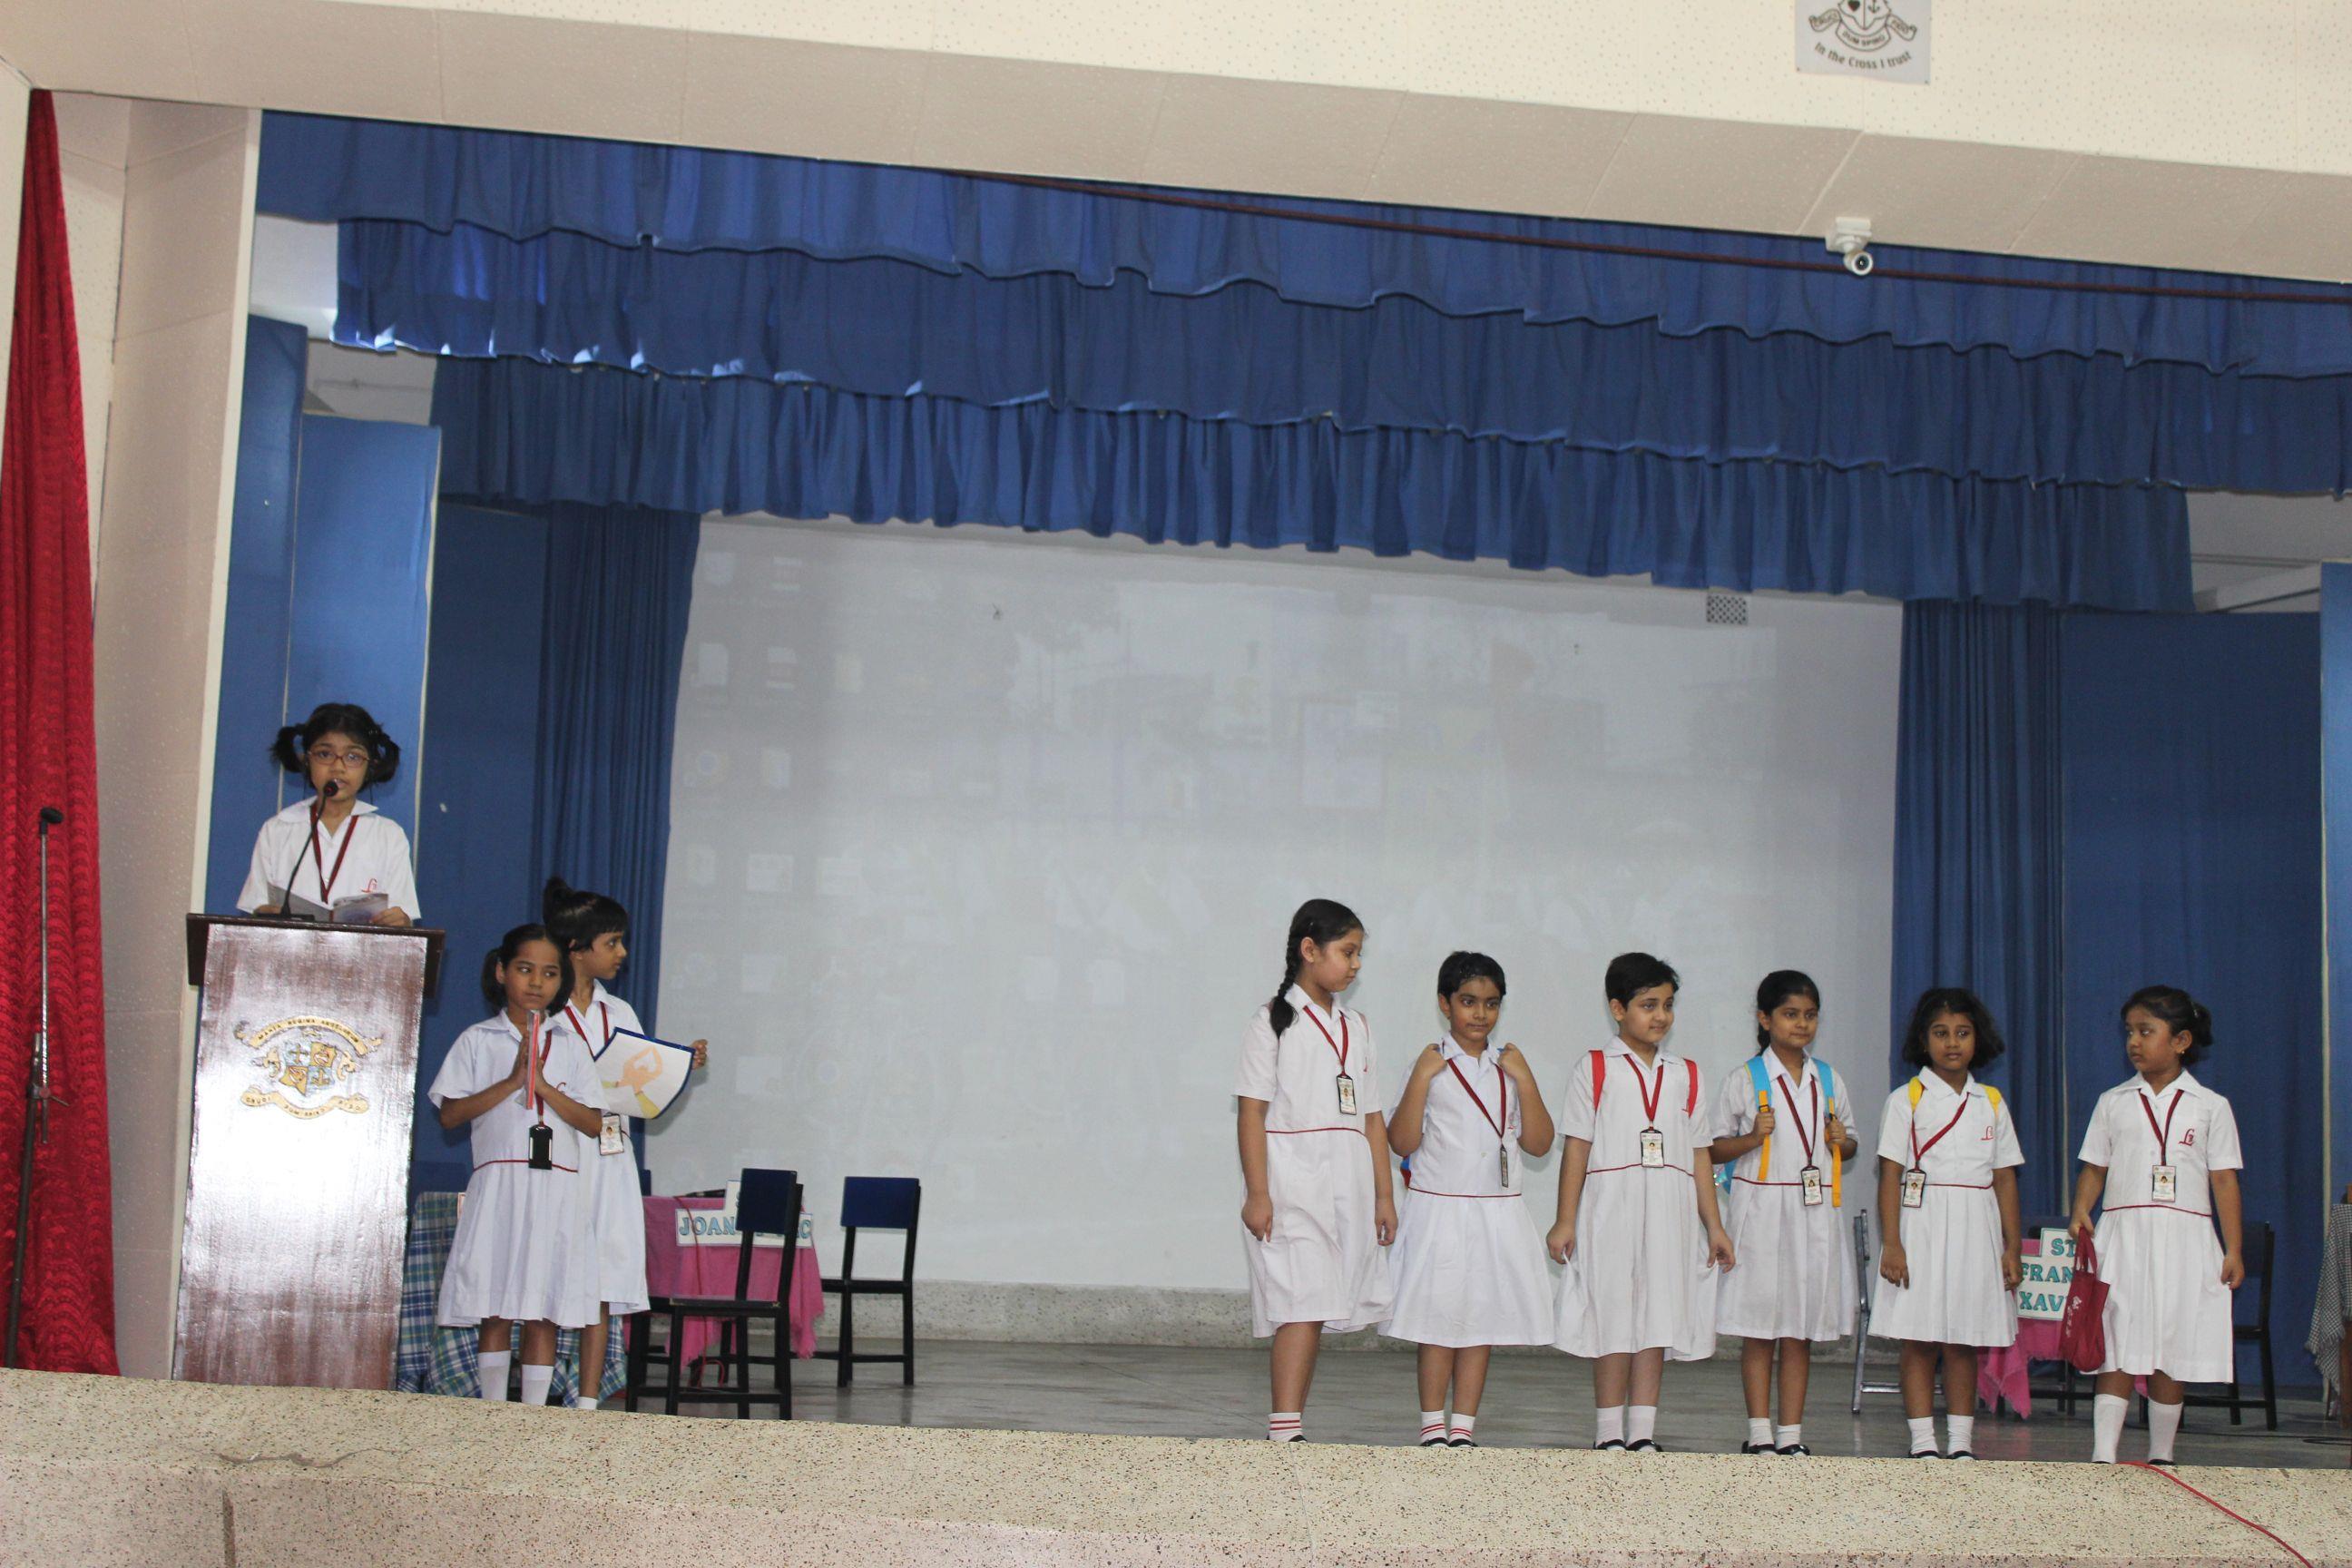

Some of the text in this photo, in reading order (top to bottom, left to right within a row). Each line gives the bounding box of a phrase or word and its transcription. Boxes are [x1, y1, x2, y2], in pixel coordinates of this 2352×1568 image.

[1815, 42, 1826, 55] In
[1828, 50, 1846, 64] the
[1848, 57, 1877, 70] Cross
[1887, 51, 1912, 67] trust
[2051, 1238, 2076, 1258] ST
